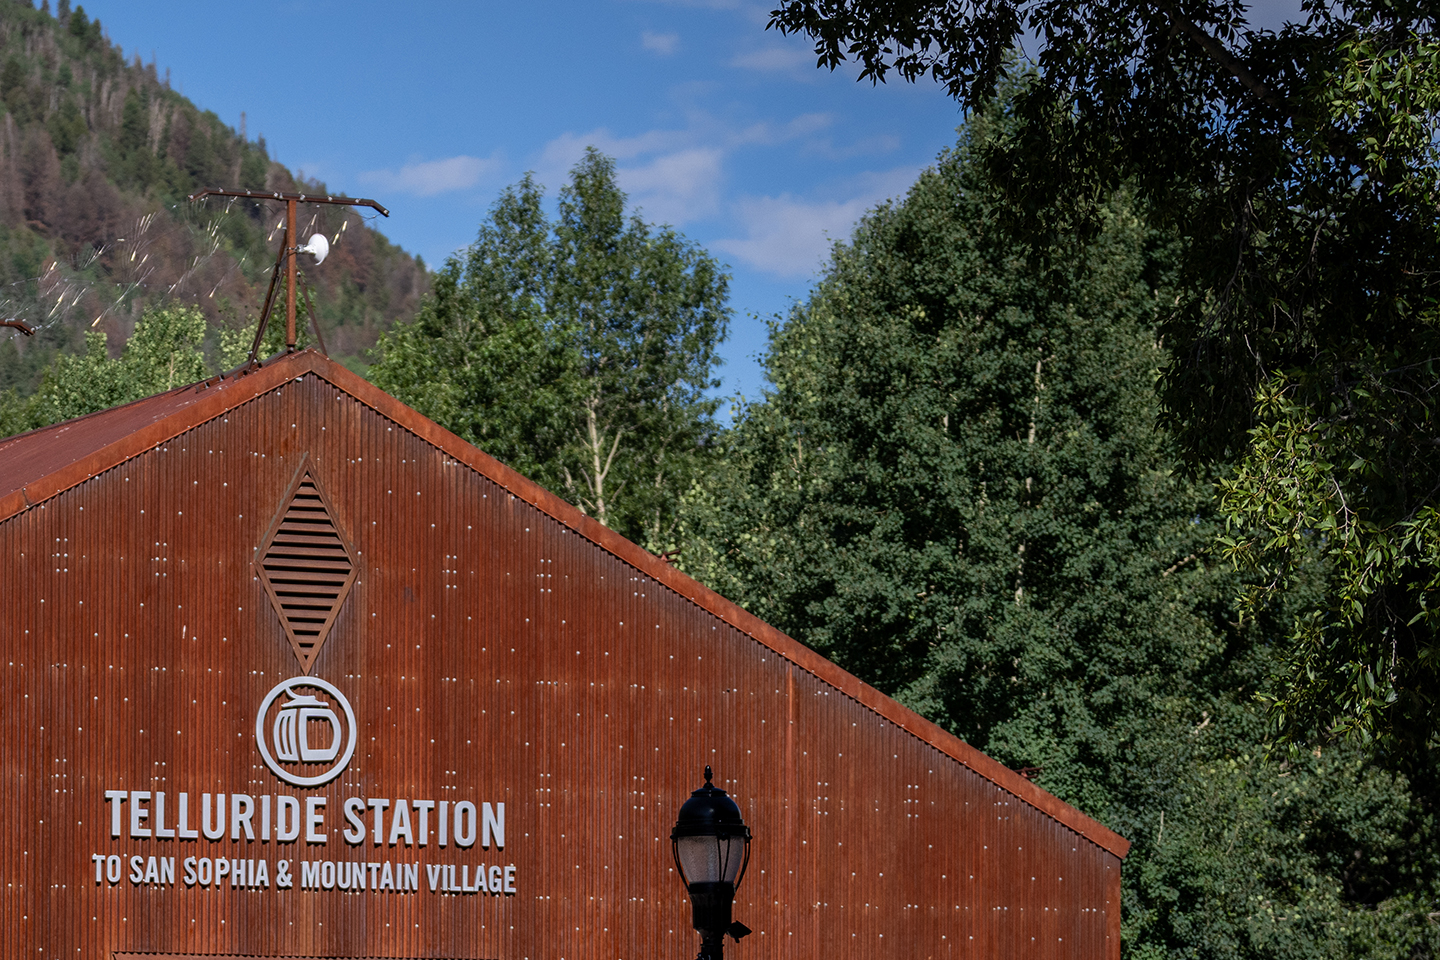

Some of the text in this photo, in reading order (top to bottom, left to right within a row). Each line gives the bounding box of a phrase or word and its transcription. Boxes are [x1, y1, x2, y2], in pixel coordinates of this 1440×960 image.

[105, 790, 506, 849] TELLURIDE STATION
[92, 854, 517, 894] TO SAN SOPHIA & MOUNTAIN VILLAGE
